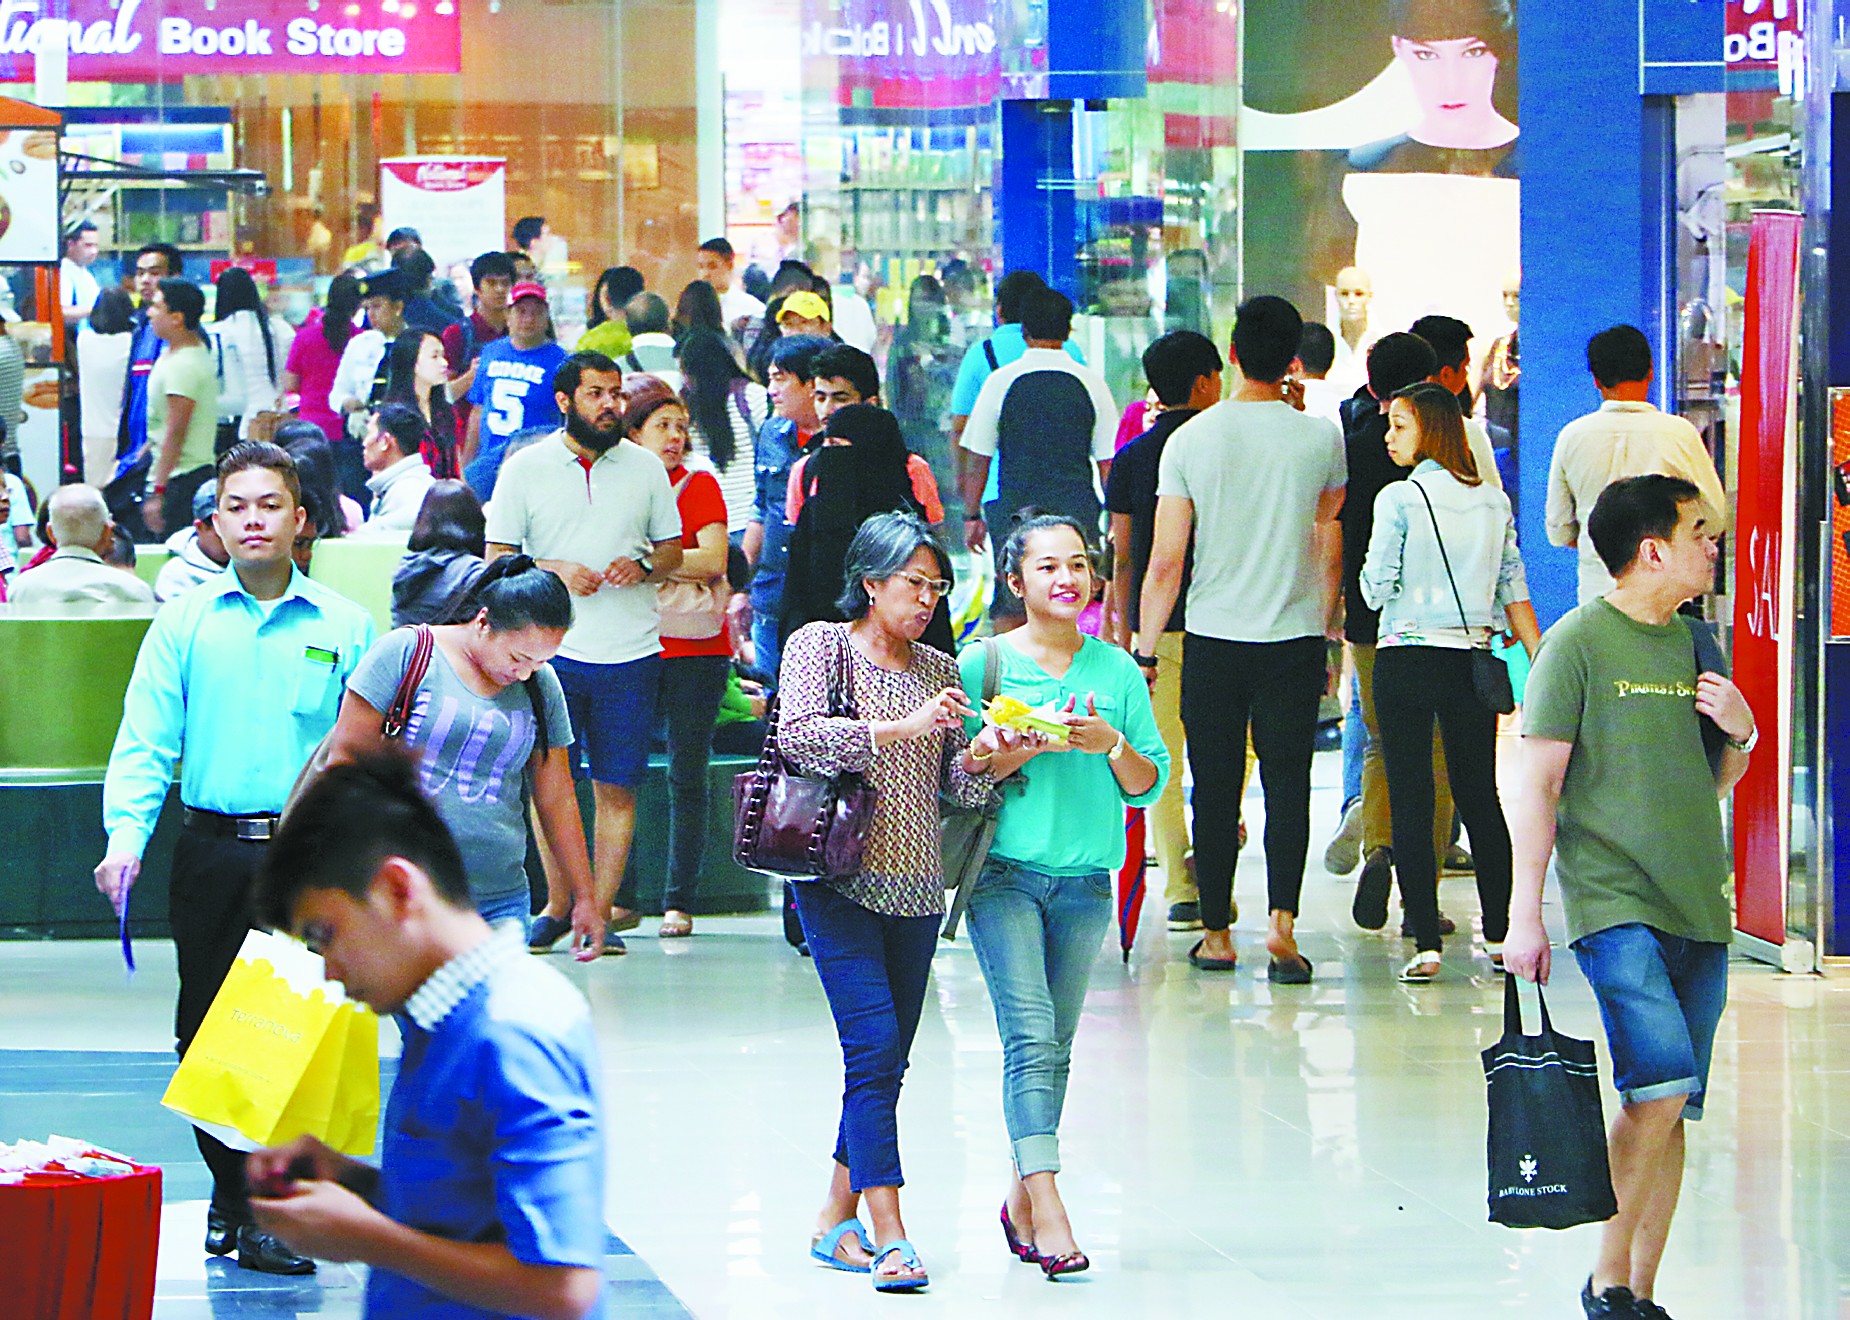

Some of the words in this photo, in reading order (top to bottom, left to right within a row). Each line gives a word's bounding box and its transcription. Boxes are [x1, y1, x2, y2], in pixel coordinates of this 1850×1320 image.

[161, 17, 273, 55] Book
[286, 17, 406, 57] Store
[487, 378, 530, 437] 5
[1536, 1184, 1568, 1196] STOCK
